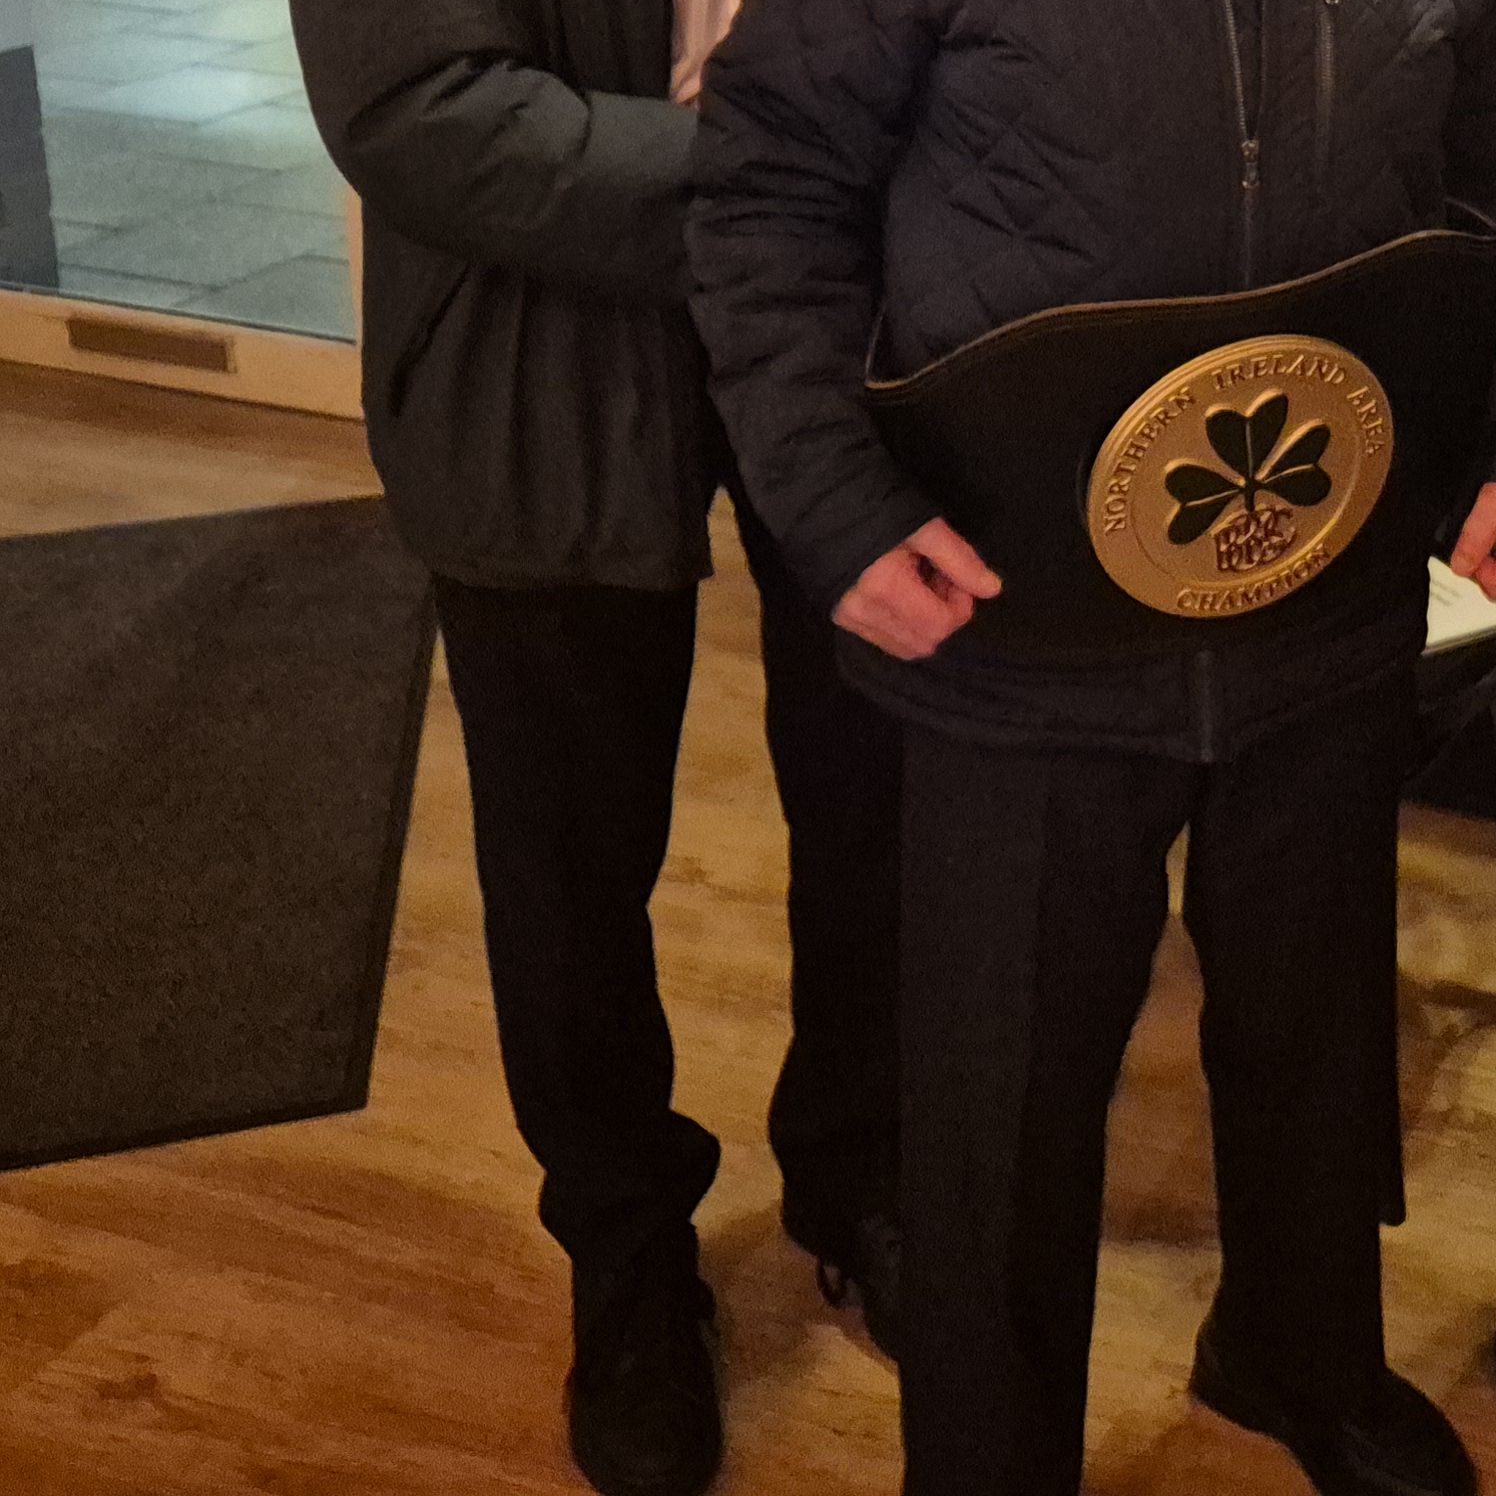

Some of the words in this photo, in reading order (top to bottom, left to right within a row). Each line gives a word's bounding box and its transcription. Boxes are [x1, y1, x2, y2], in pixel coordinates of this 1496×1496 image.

[1103, 385, 1197, 536] NORTHERN
[1211, 353, 1348, 391] IRELAND
[1346, 385, 1387, 457] AREA
[1176, 543, 1332, 613] CHAMPION
